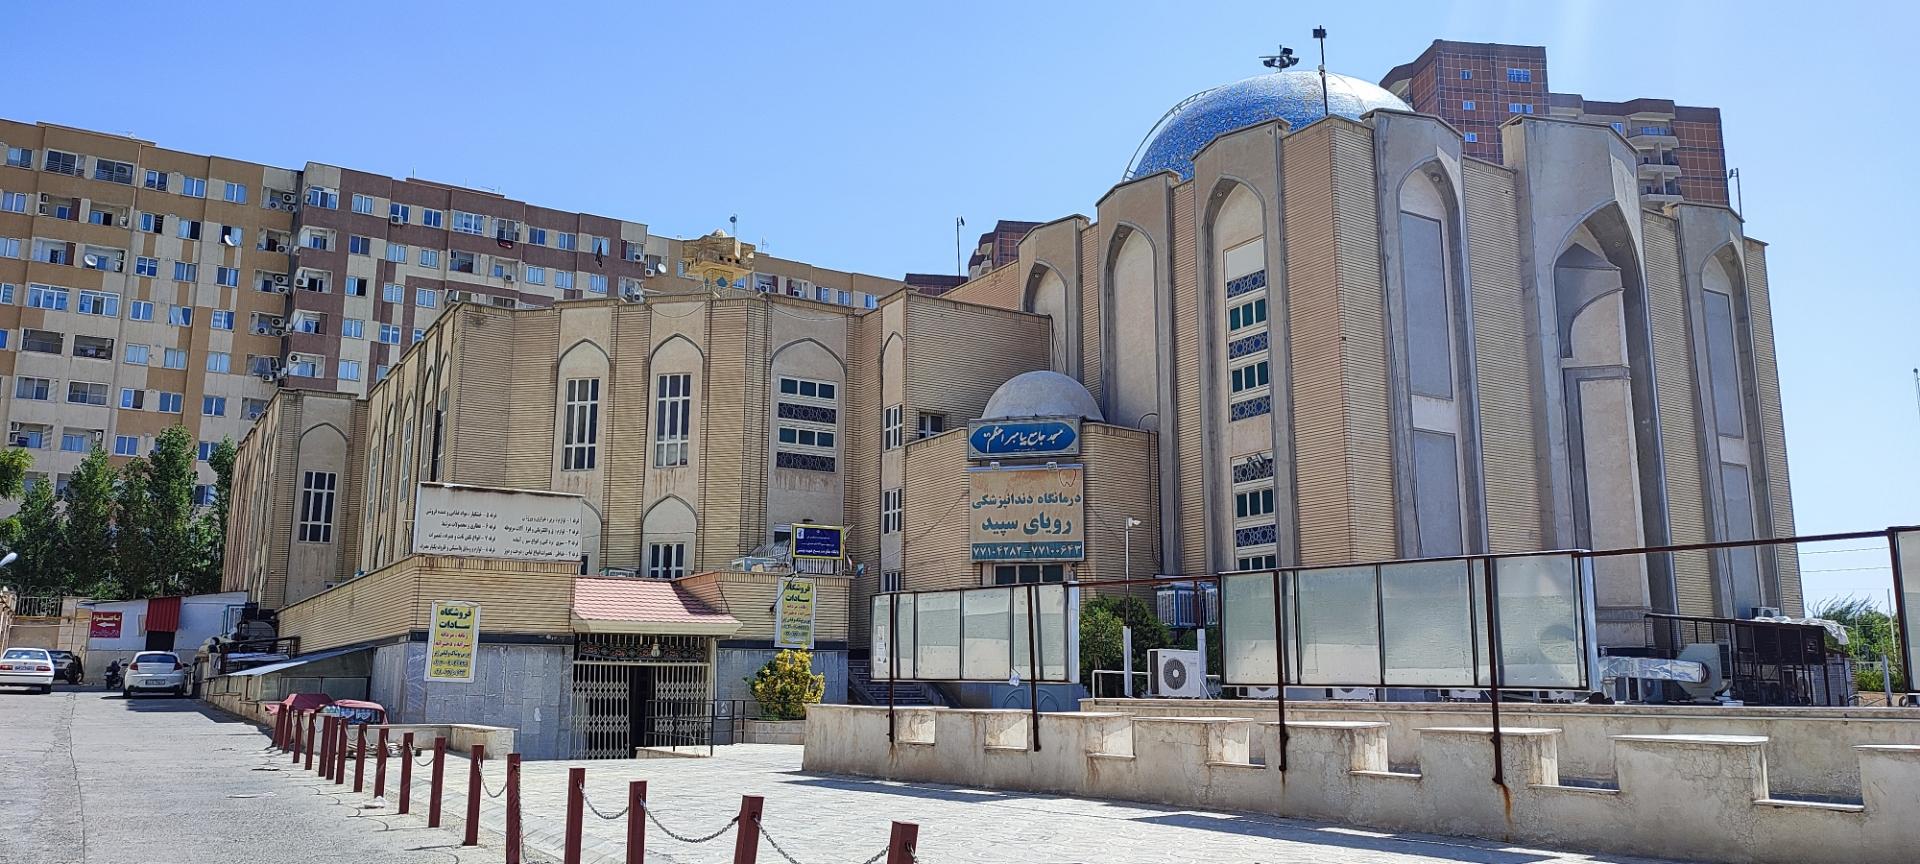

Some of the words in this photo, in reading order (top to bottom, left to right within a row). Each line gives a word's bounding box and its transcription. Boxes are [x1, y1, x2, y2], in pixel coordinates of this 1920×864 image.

[987, 426, 1004, 453] اعظم
[1004, 432, 1027, 446] پیامبر
[1028, 430, 1046, 445] جامع
[1048, 429, 1063, 444] مسجد
[972, 493, 1033, 509] دندانپزشکی
[1038, 492, 1081, 506] درمانگاه
[982, 517, 1018, 536] سپید
[1024, 512, 1071, 534] رویای
[786, 594, 809, 602] سادات
[441, 608, 471, 619] فروشگاه
[439, 621, 470, 629] سادات
